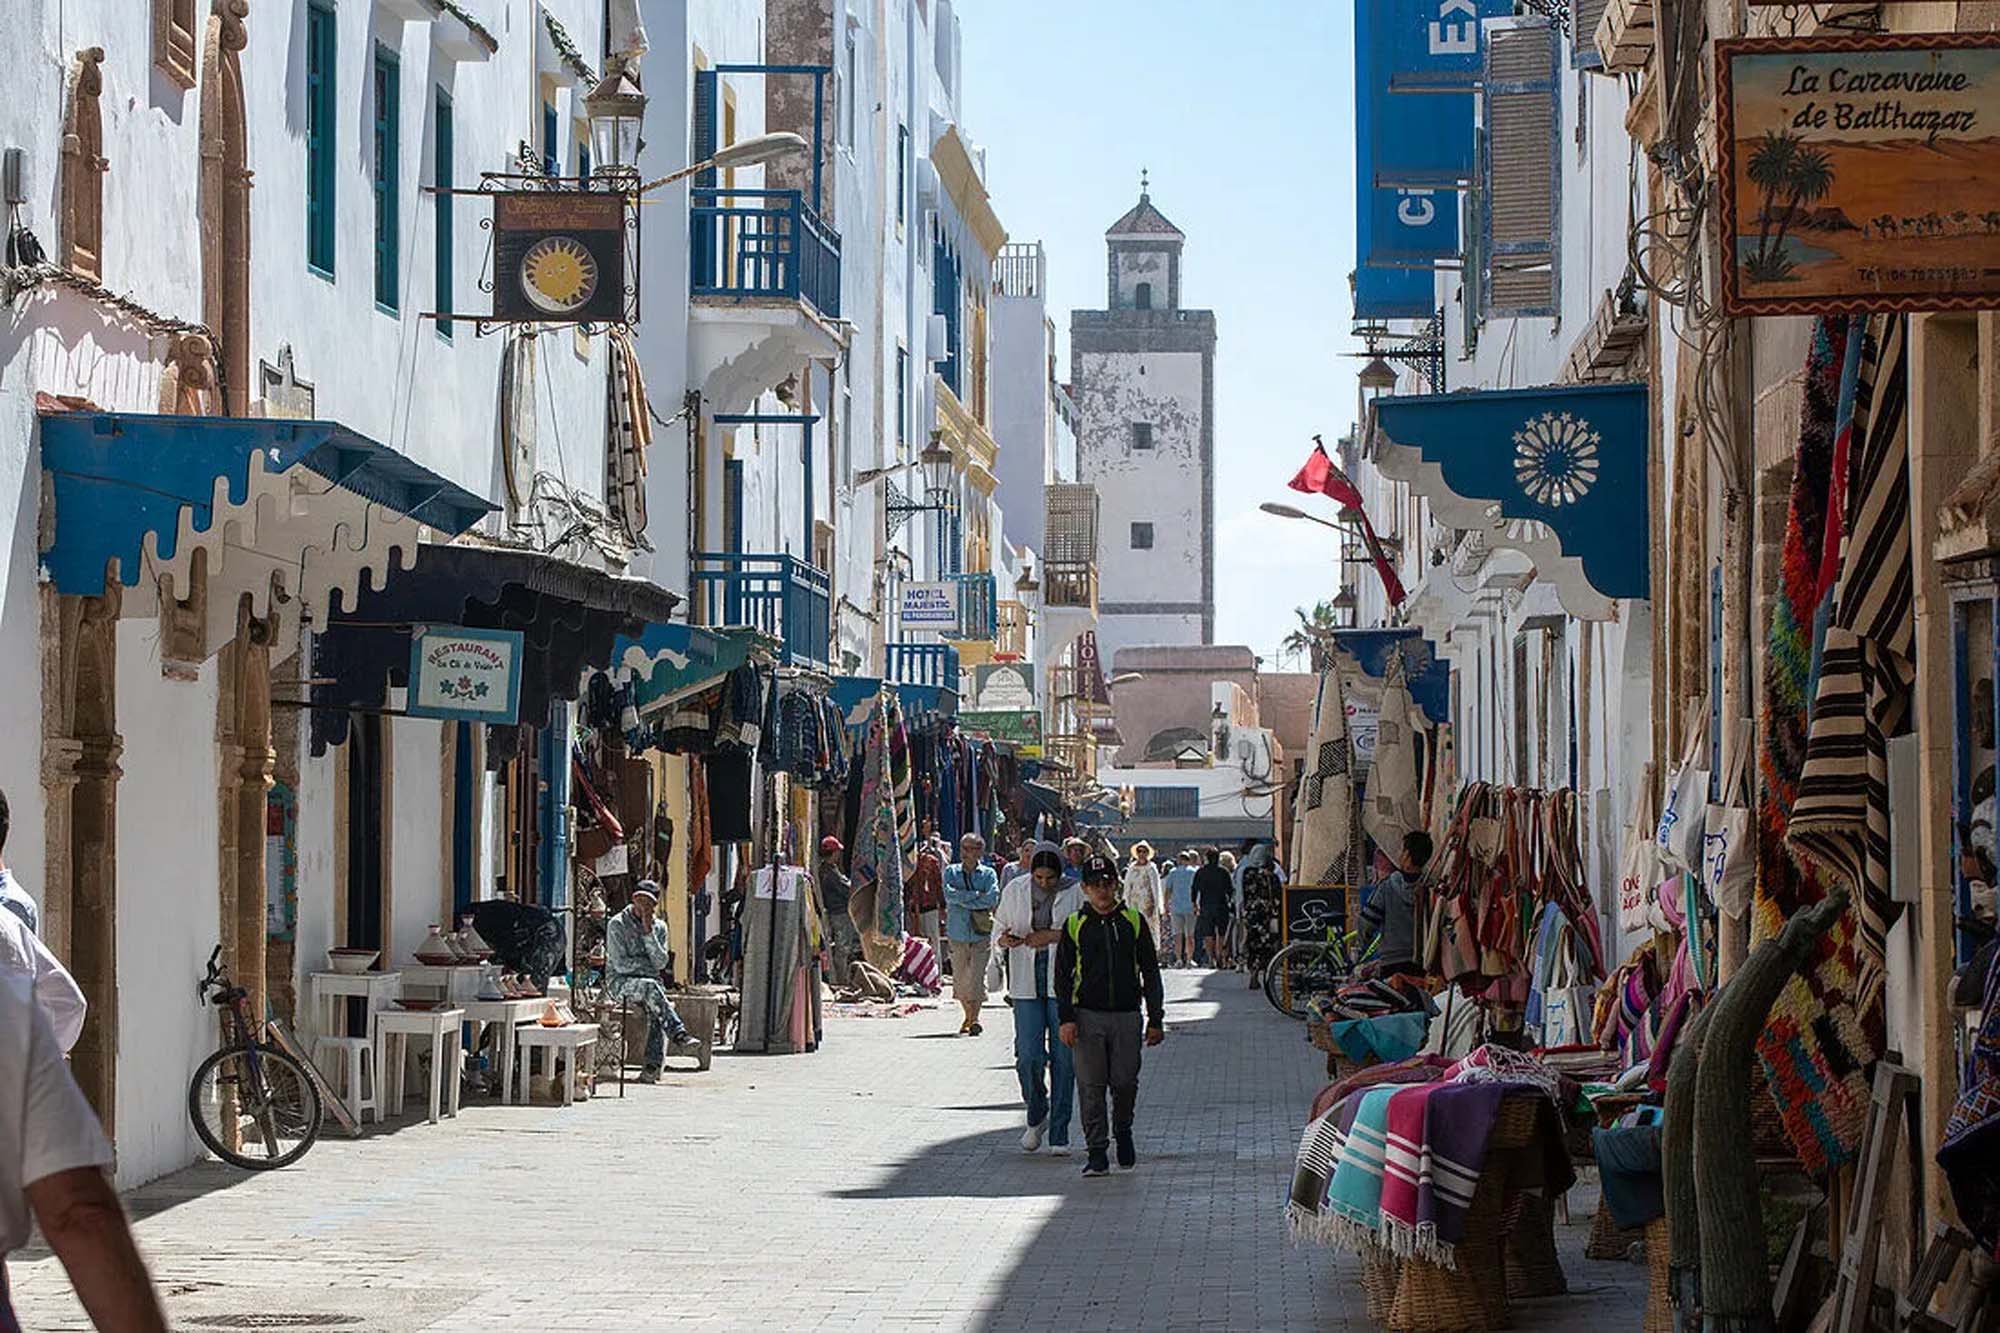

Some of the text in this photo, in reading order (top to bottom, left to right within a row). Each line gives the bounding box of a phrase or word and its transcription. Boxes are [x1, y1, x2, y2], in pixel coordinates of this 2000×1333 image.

[1782, 65, 1972, 96] La Caravane
[1792, 101, 1977, 141] de Balthazar
[903, 600, 950, 610] MAJESTIC
[907, 589, 946, 600] HOTEL
[427, 643, 504, 670] RESTAURANT
